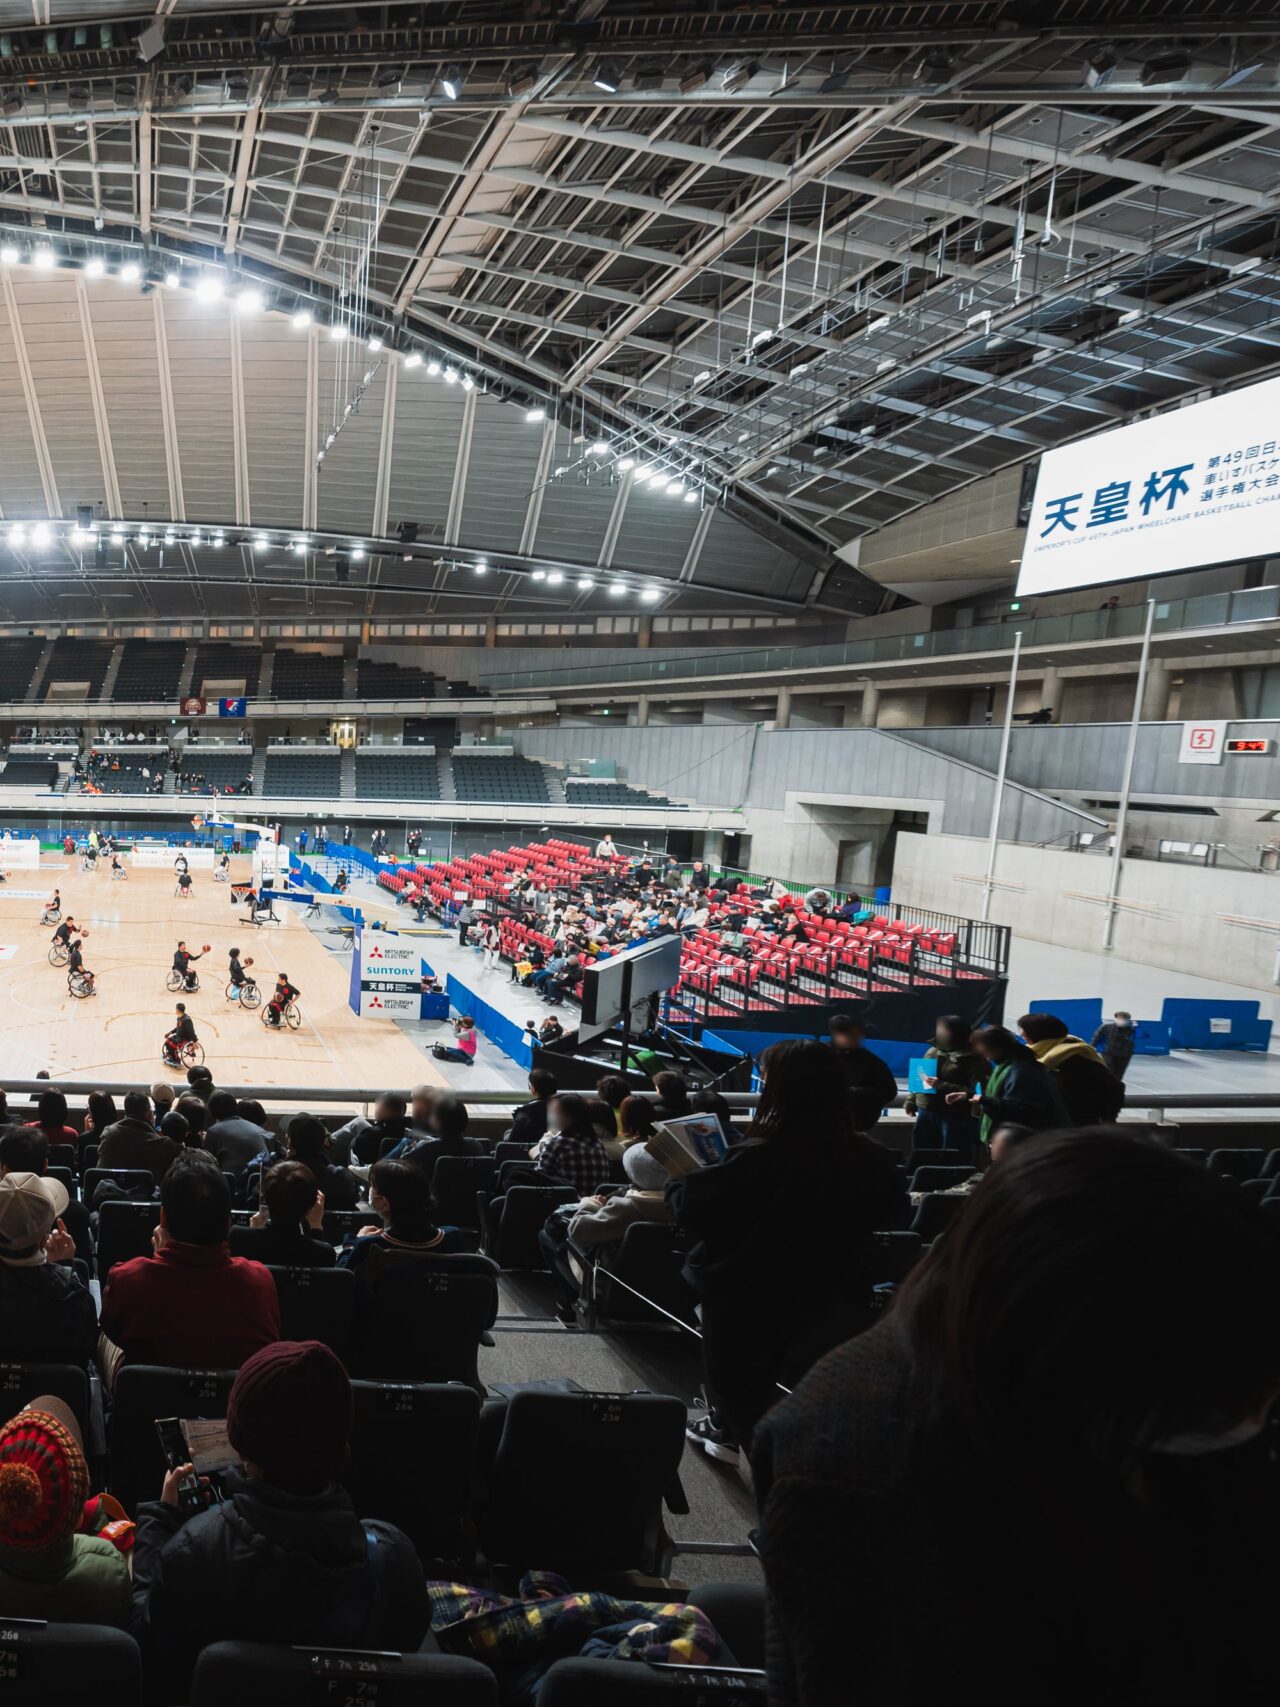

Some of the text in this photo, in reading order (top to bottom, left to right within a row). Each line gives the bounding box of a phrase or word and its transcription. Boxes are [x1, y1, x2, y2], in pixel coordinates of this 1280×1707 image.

[1207, 441, 1280, 469] 第49回日
[1040, 463, 1195, 538] 天皇杯
[1193, 500, 1252, 518] BASKETBALL
[367, 966, 415, 975] SUNTORY
[369, 982, 395, 991] 天皇杯
